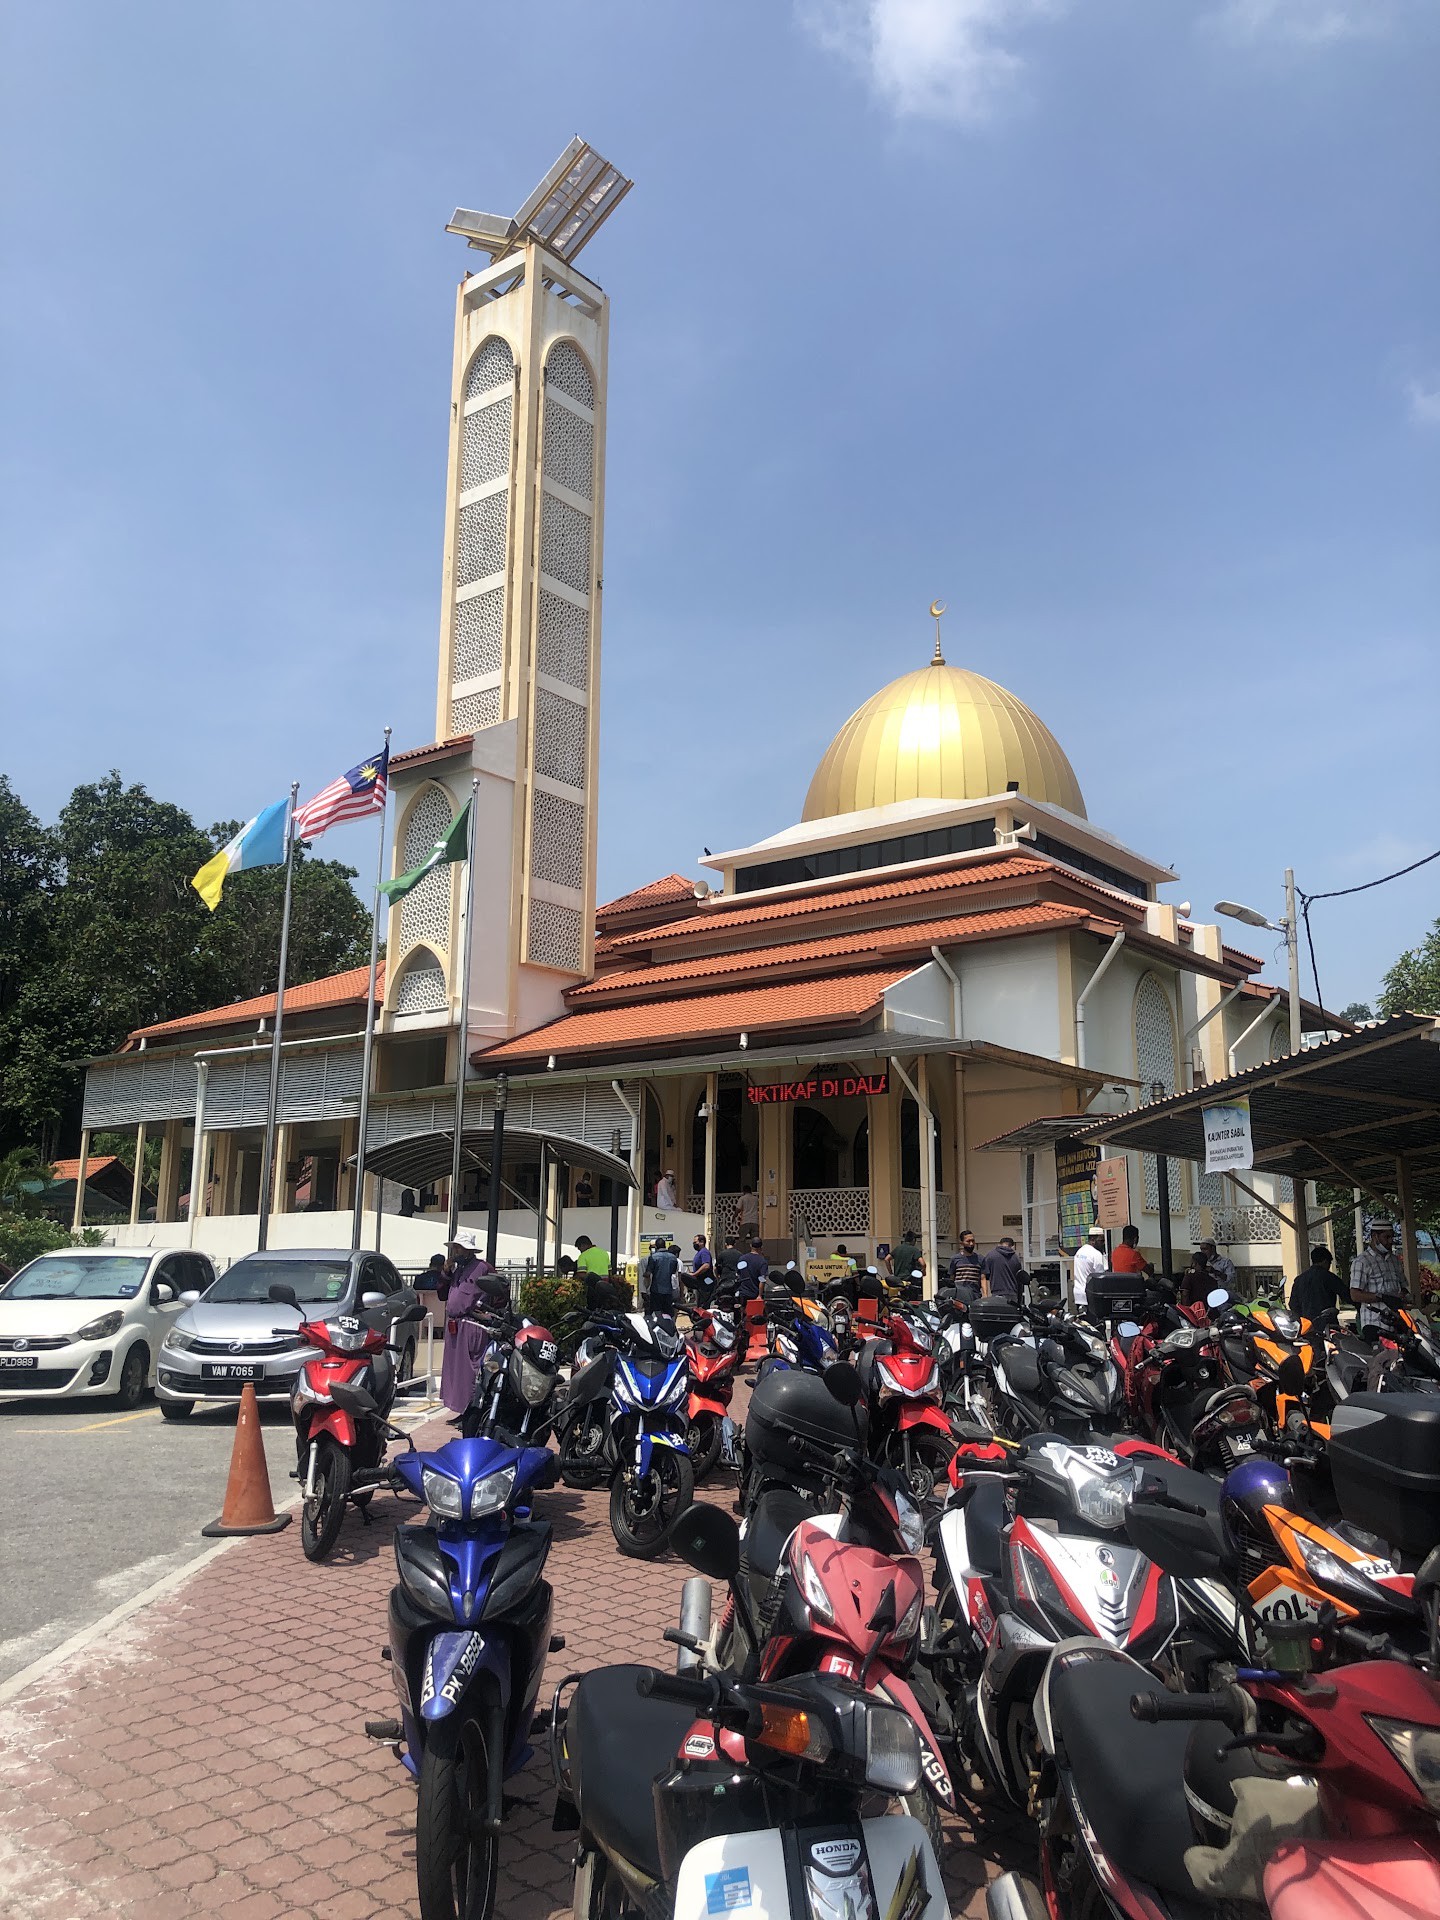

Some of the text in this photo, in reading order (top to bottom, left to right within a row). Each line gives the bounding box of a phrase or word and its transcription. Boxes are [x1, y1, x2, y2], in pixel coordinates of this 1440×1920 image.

[822, 1080, 838, 1097] DI
[1207, 1127, 1245, 1142] KAUNTER SABIL
[338, 1316, 359, 1324] PPM
[341, 1321, 359, 1330] 314
[212, 1366, 254, 1377] VAW 7065
[919, 1737, 952, 1796] 493
[815, 1843, 858, 1855] HONDA
